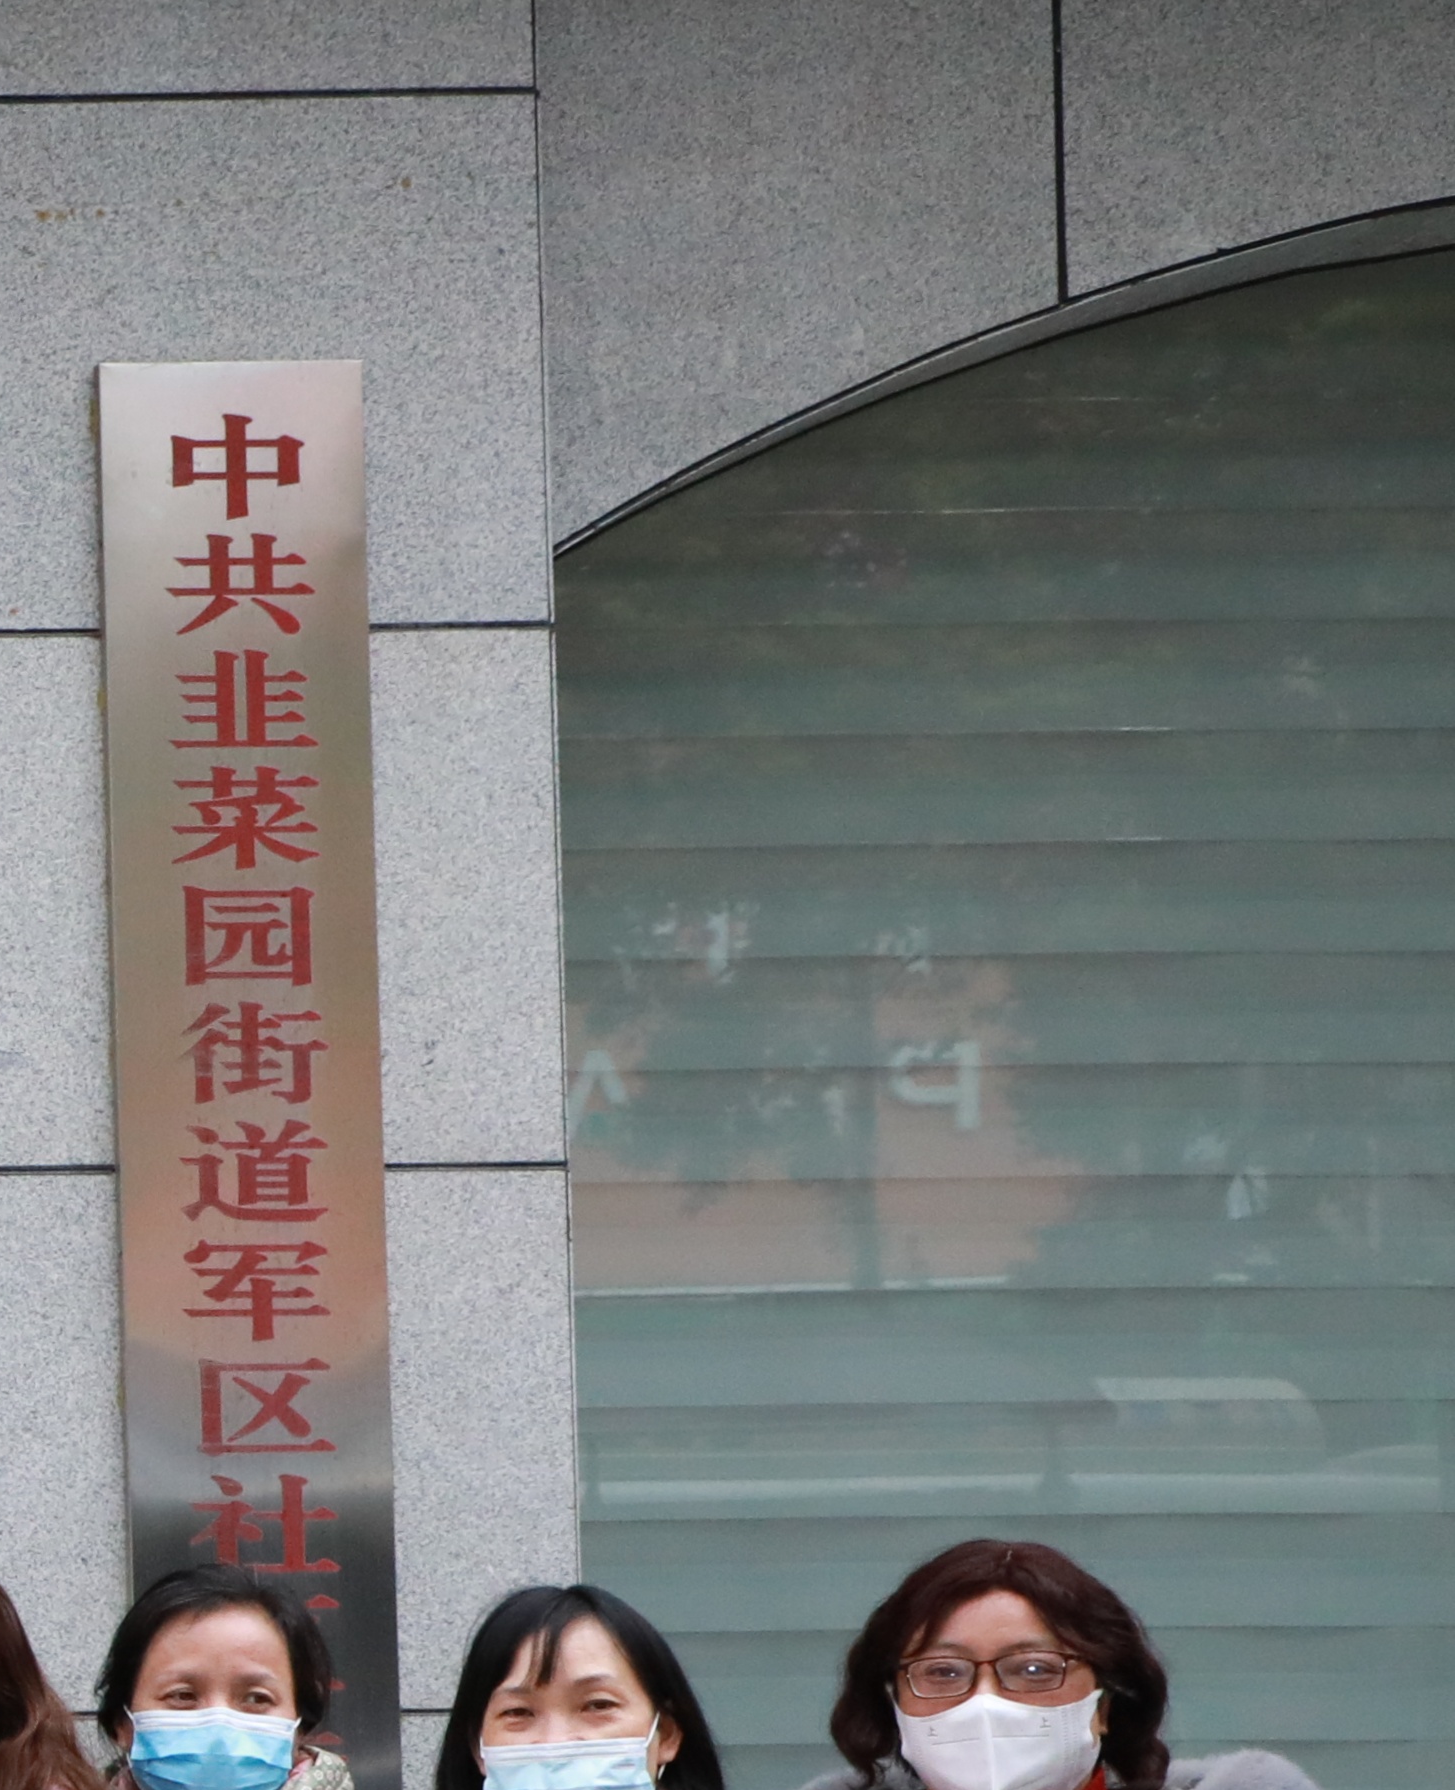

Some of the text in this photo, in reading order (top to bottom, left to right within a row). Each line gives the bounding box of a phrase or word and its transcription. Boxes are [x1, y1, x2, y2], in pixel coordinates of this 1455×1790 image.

[165, 414, 346, 1692] 中共韭菜园街道军区社
